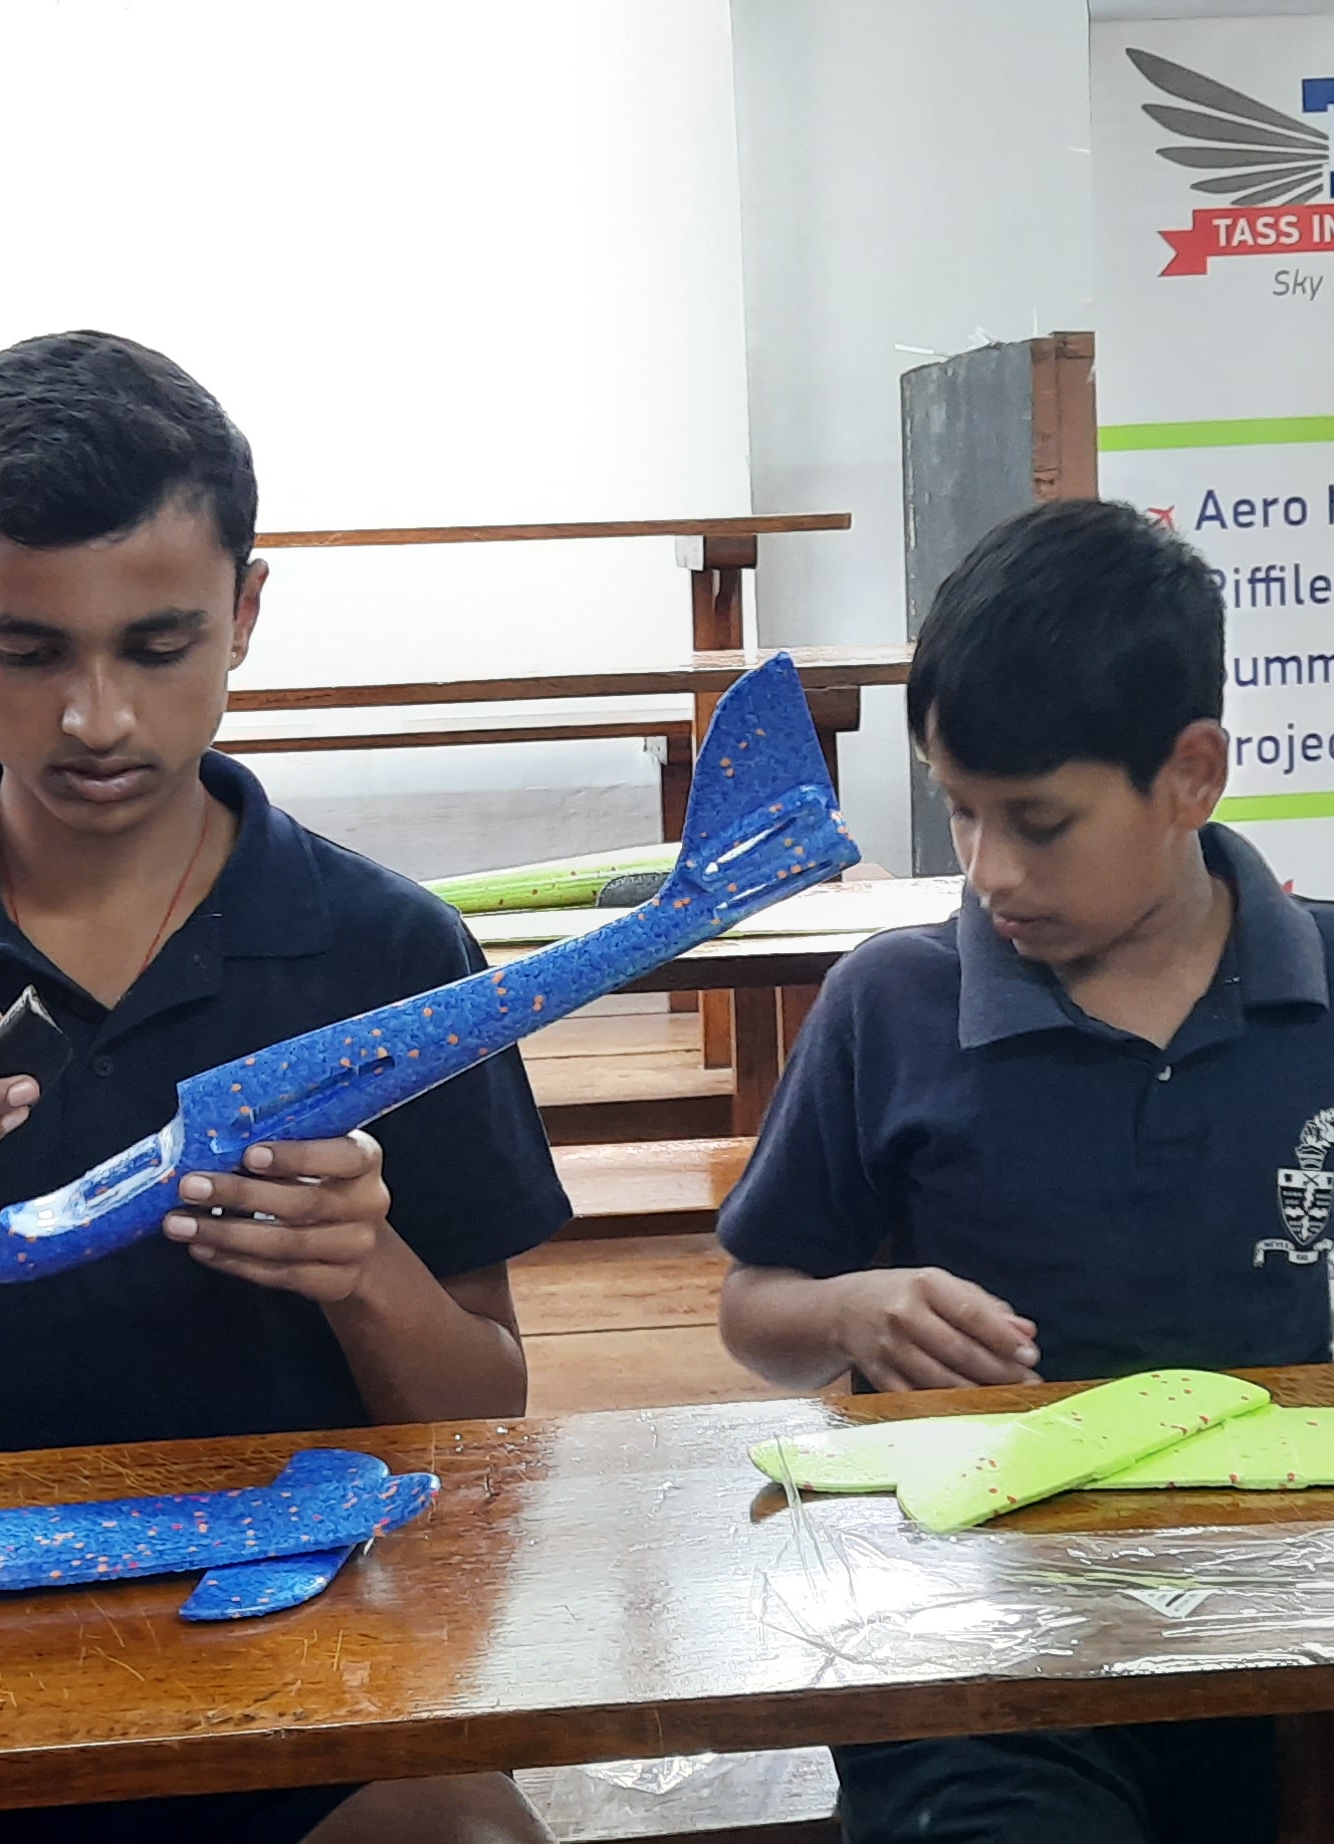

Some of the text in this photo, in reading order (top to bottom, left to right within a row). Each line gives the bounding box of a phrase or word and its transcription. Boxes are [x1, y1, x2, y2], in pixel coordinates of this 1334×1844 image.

[1212, 215, 1301, 247] TASS
[1272, 268, 1324, 304] Sky
[1194, 489, 1309, 531] Aero
